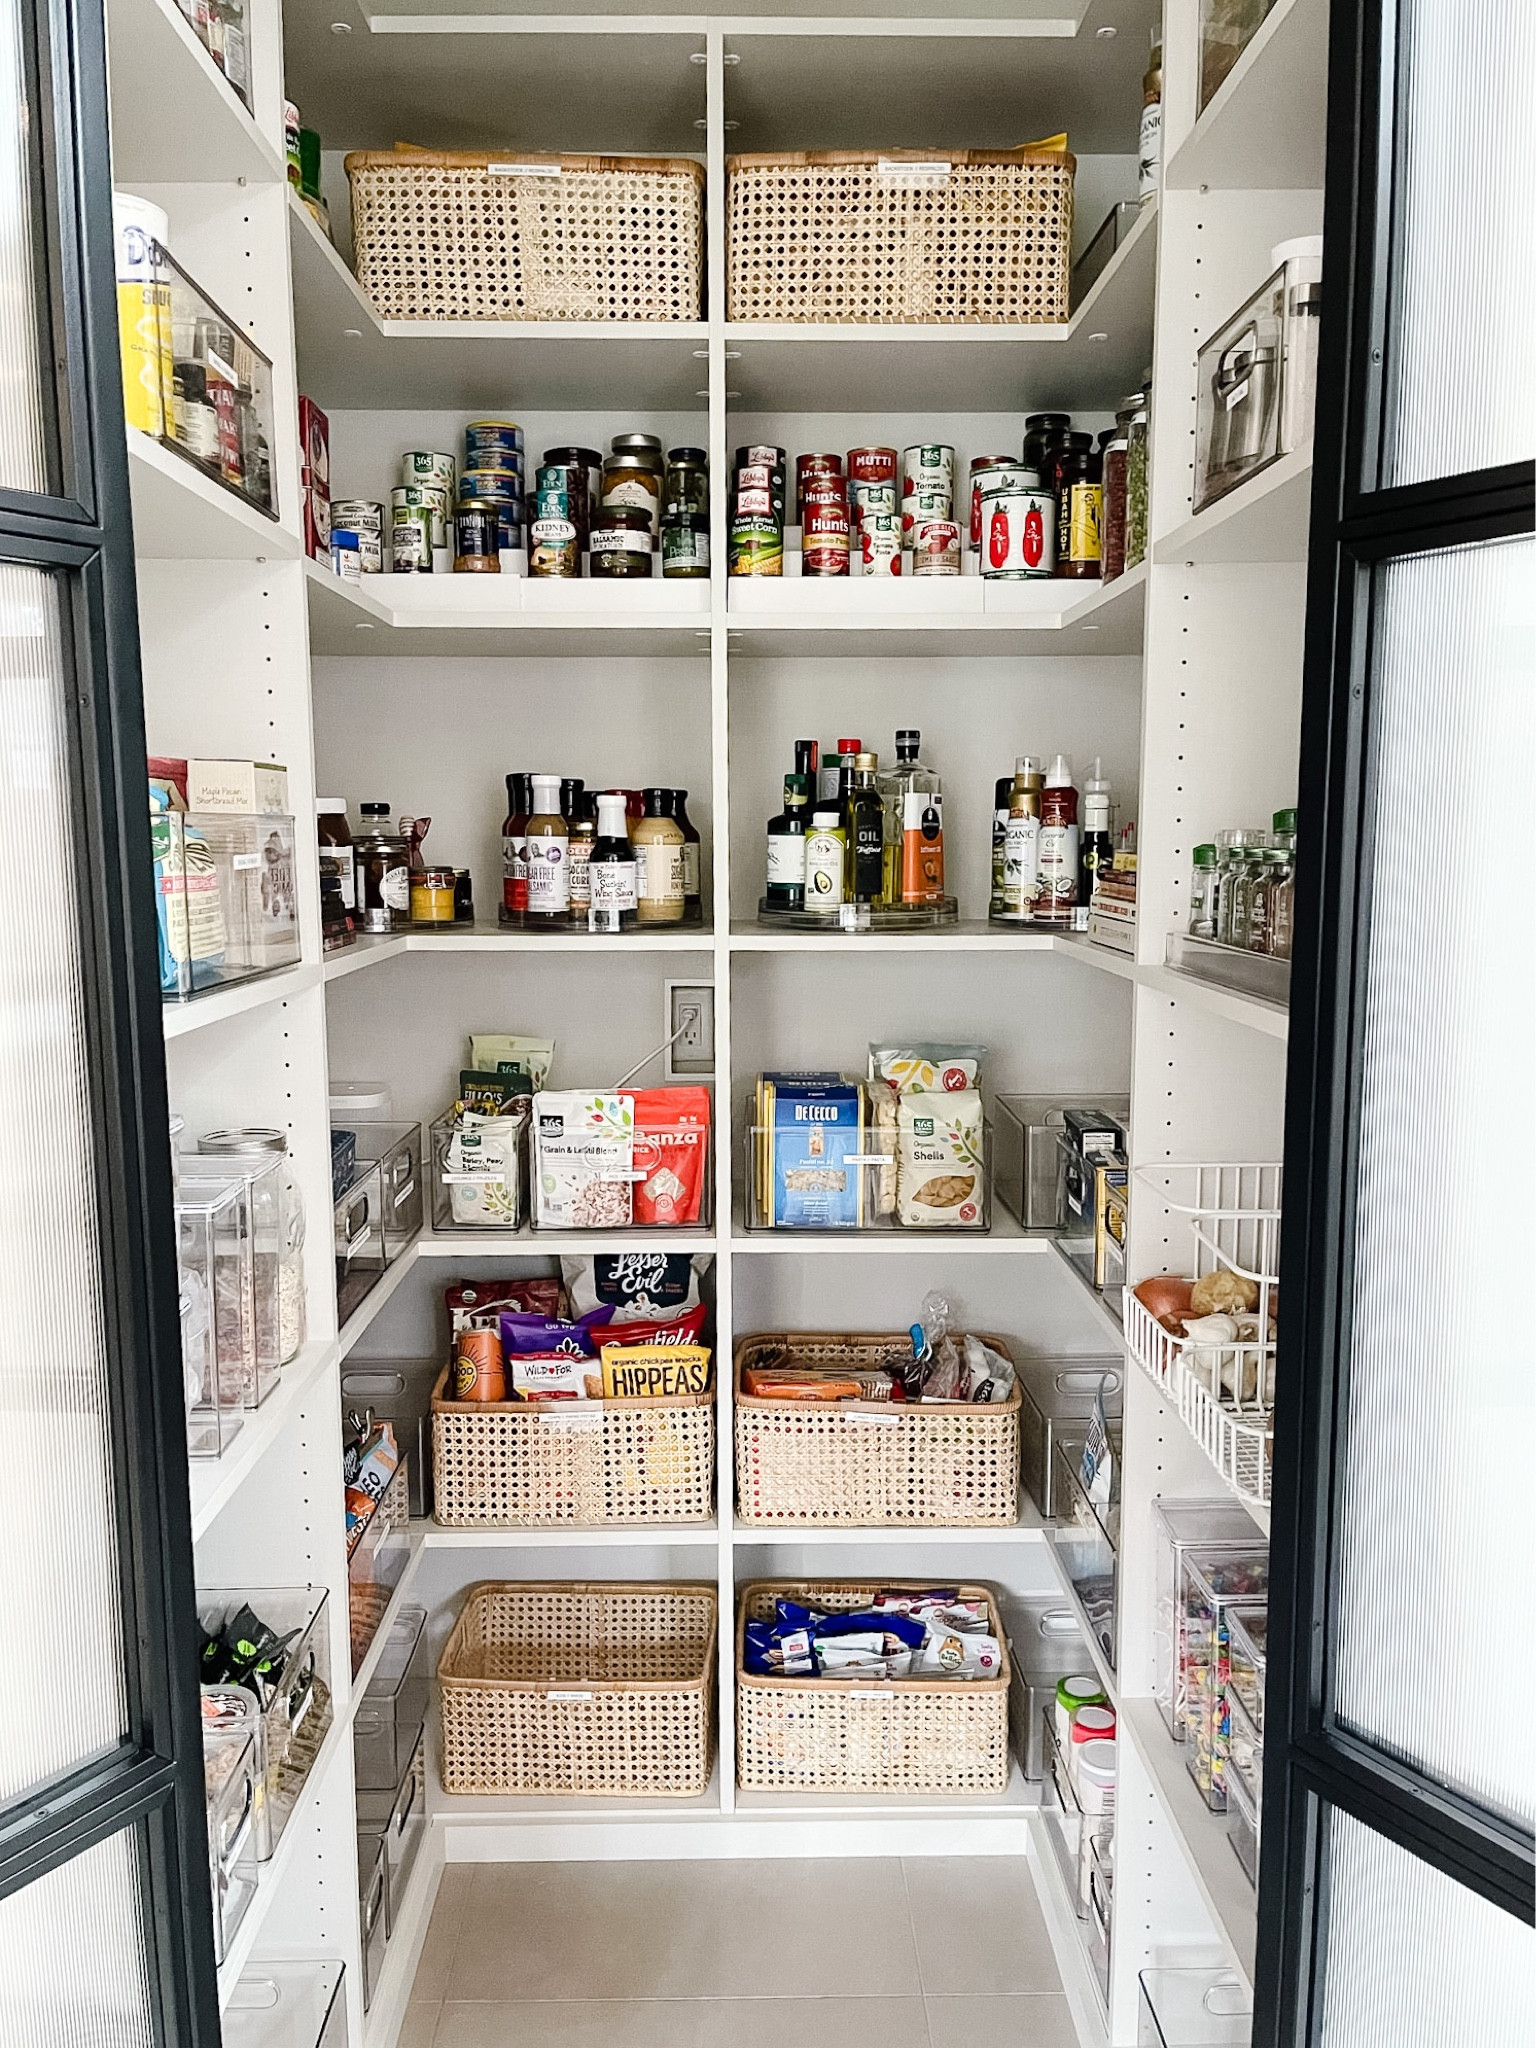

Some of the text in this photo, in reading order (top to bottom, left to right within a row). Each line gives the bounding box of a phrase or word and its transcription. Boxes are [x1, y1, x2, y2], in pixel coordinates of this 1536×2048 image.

[415, 456, 432, 466] 365
[856, 455, 892, 467] MUTTI
[922, 451, 940, 460] 365
[915, 481, 946, 490] Tomato
[407, 490, 422, 500] 365
[541, 502, 564, 512] EDEN
[812, 517, 849, 533] Hunt's
[877, 517, 891, 527] 365
[535, 523, 572, 534] KIDNEY
[755, 522, 778, 535] Corn
[858, 830, 880, 843] OIL
[542, 1118, 563, 1133] 365
[634, 1131, 699, 1147] Banza
[545, 1145, 565, 1154] Grain
[566, 1146, 572, 1154] &
[913, 1150, 945, 1162] Shells
[608, 1253, 669, 1280] Lesser
[621, 1267, 665, 1294] Evil
[611, 1358, 639, 1367] organic
[640, 1356, 674, 1366] chickpea
[524, 1364, 549, 1377] WILD
[555, 1364, 573, 1375] FOR
[611, 1363, 705, 1397] HIPPEAS
